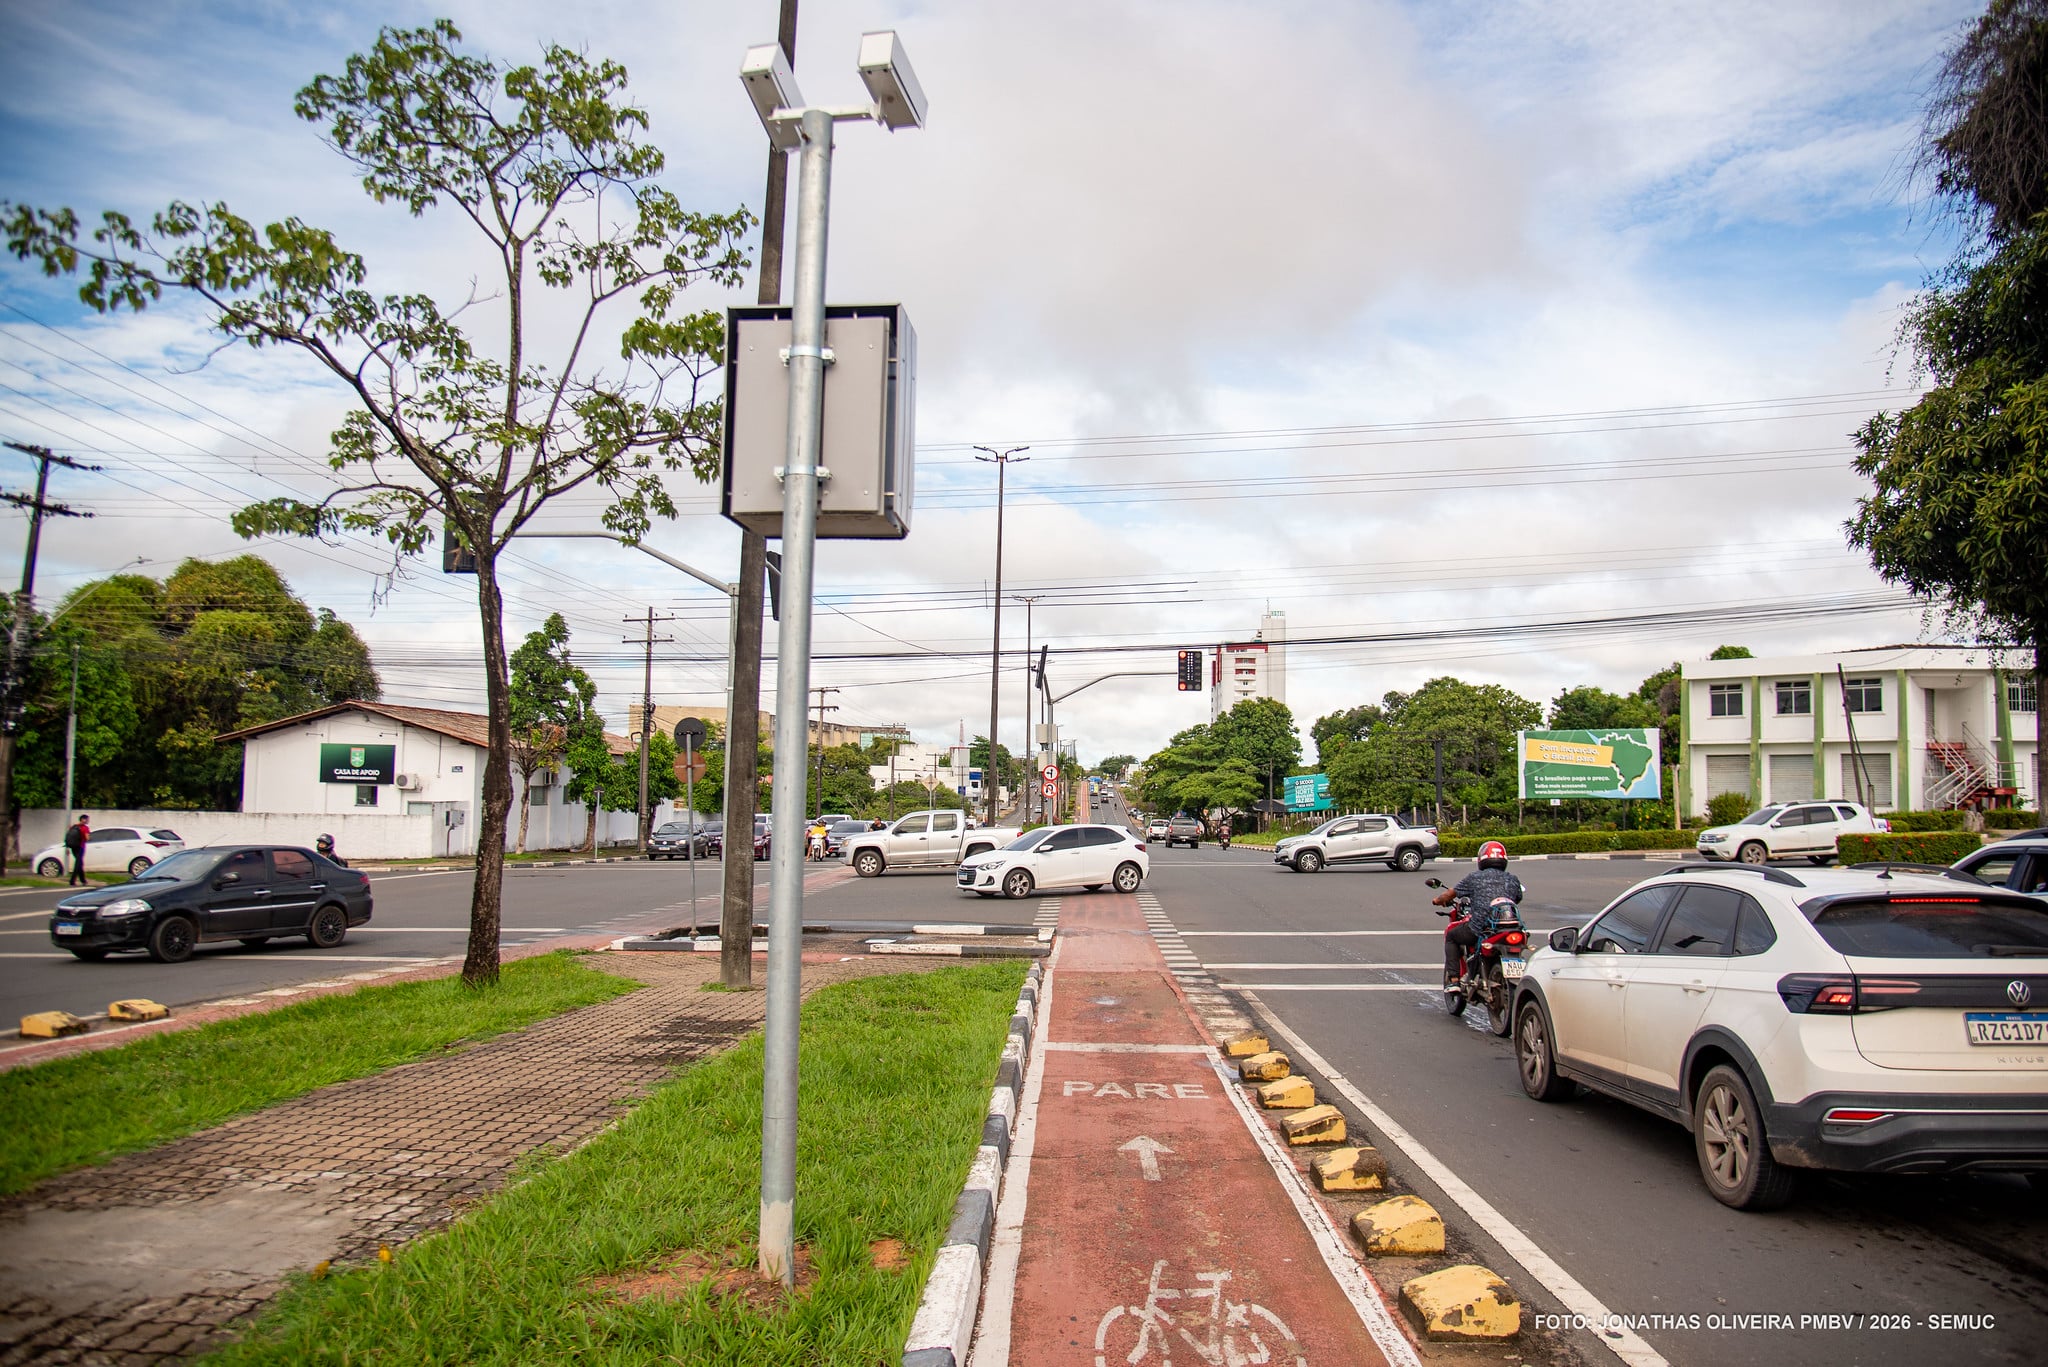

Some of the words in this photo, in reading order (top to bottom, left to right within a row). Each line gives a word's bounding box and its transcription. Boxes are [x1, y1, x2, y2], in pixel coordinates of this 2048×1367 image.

[1540, 744, 1557, 752] Sem
[1551, 752, 1574, 761] Brasil
[1977, 1023, 2048, 1041] RZC1D7
[1063, 1080, 1210, 1099] PARE
